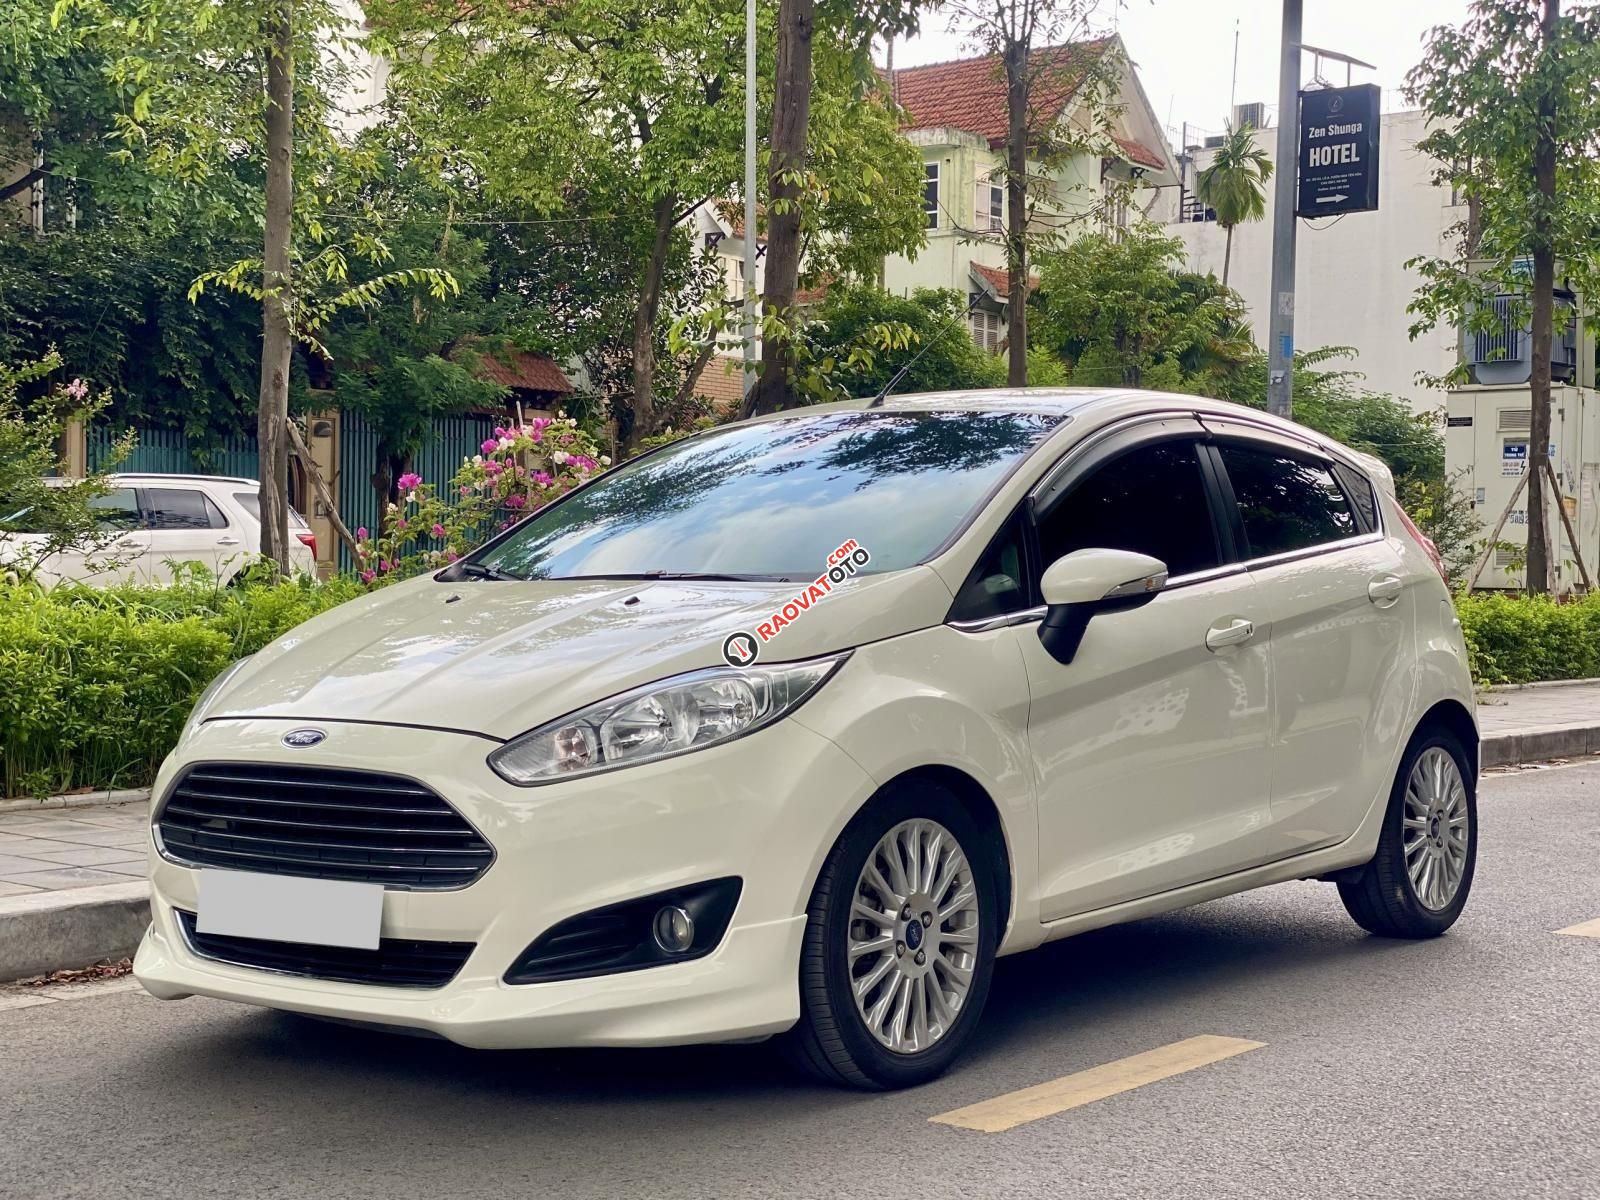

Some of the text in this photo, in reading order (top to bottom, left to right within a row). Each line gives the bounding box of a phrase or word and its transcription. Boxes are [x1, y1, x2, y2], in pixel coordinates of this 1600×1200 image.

[1308, 122, 1363, 139] Zen Shunga
[1309, 142, 1360, 167] HOTEL
[288, 731, 318, 744] Ford
